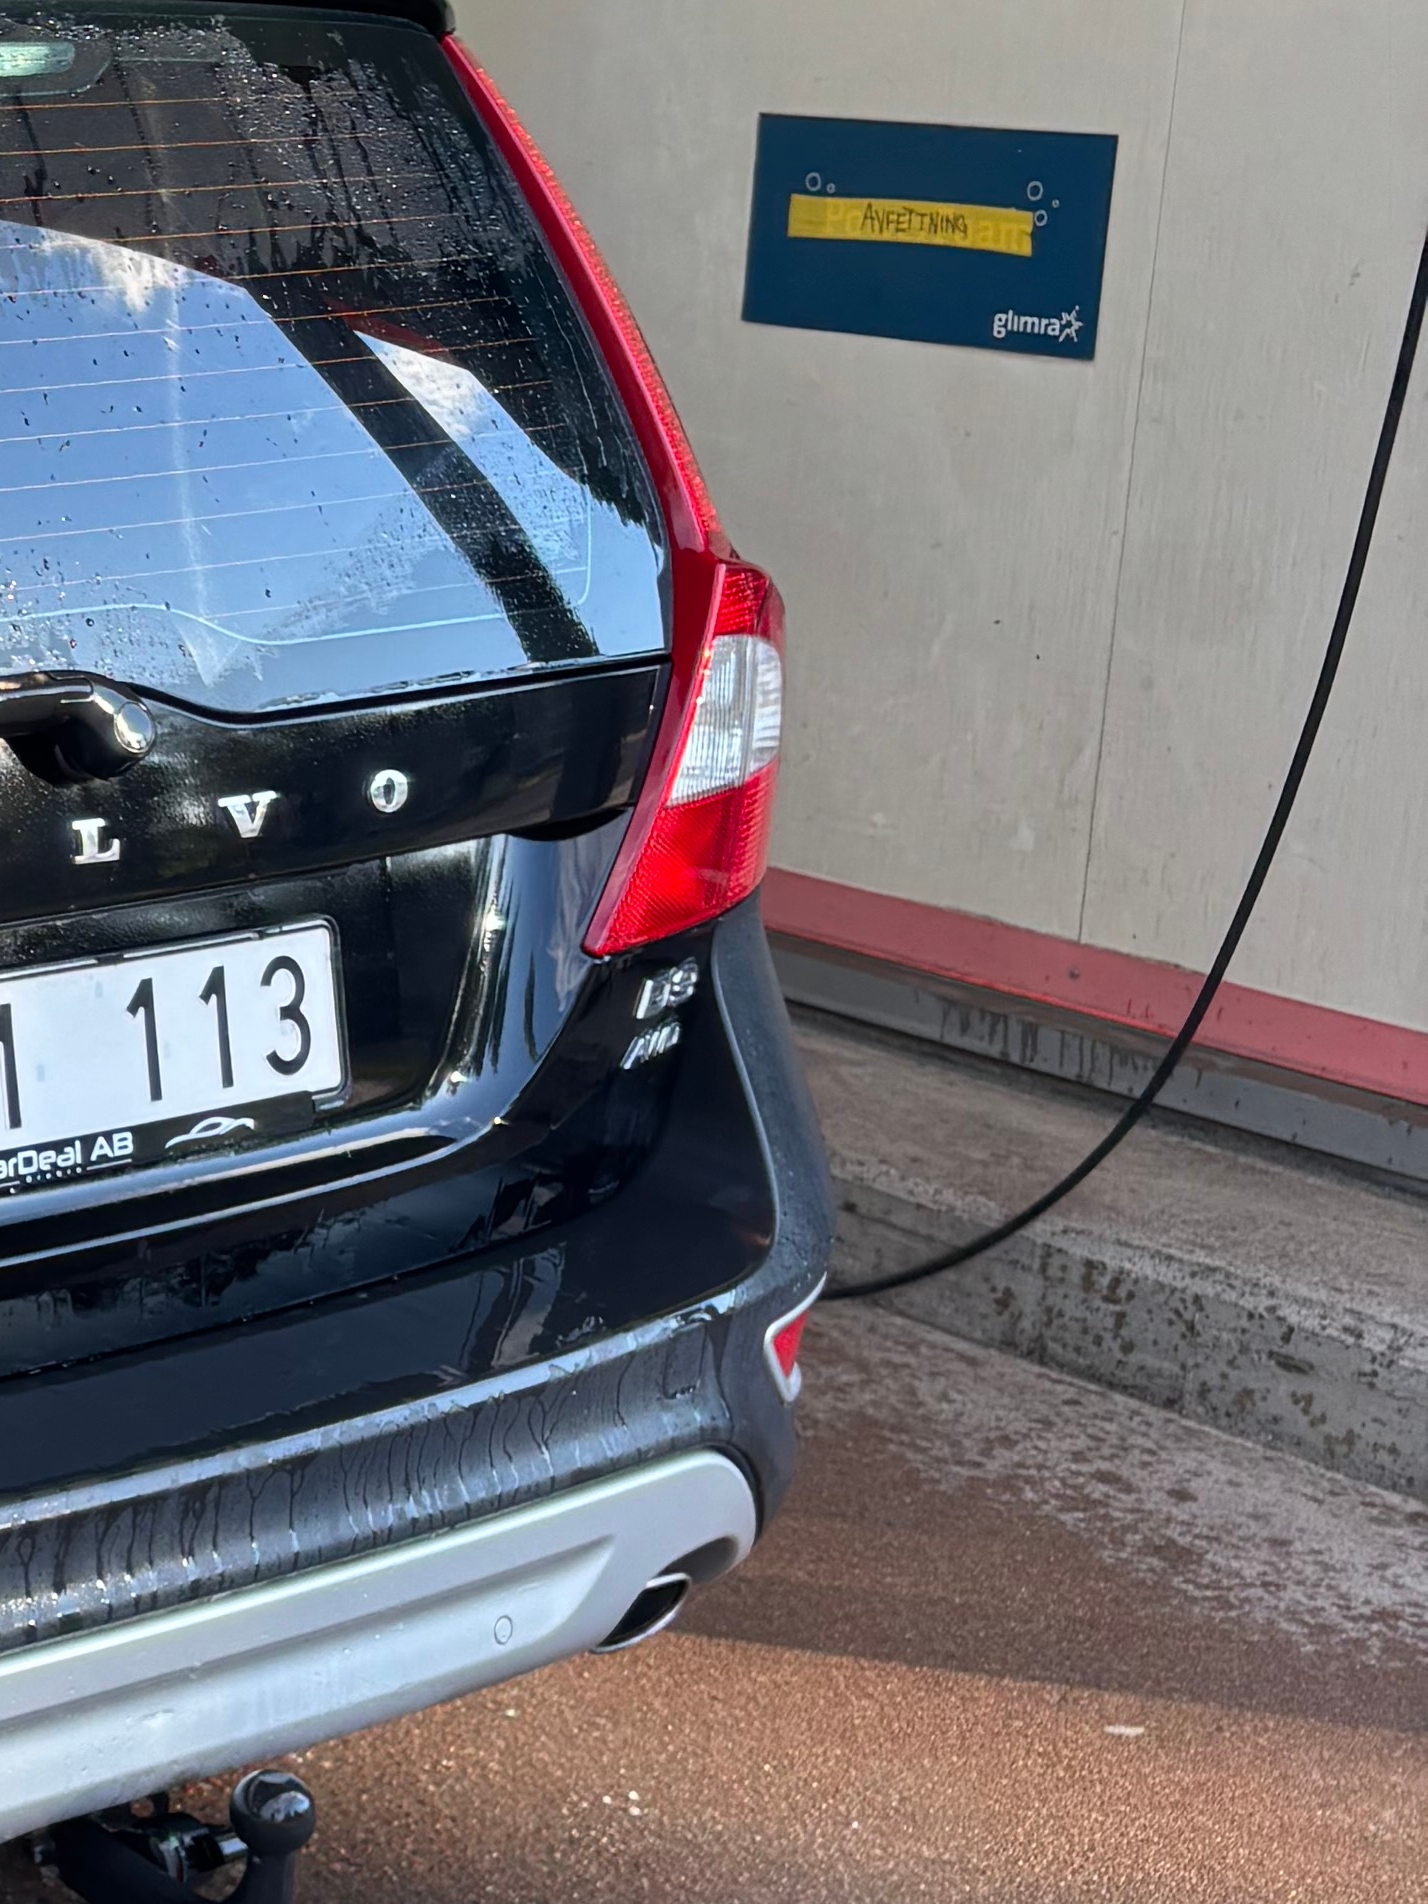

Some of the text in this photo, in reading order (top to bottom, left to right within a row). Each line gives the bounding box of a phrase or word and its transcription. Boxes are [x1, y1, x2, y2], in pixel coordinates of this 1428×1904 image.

[860, 202, 968, 237] AVFETTNING
[124, 955, 312, 1102] 113
[89, 1131, 134, 1162] AB
